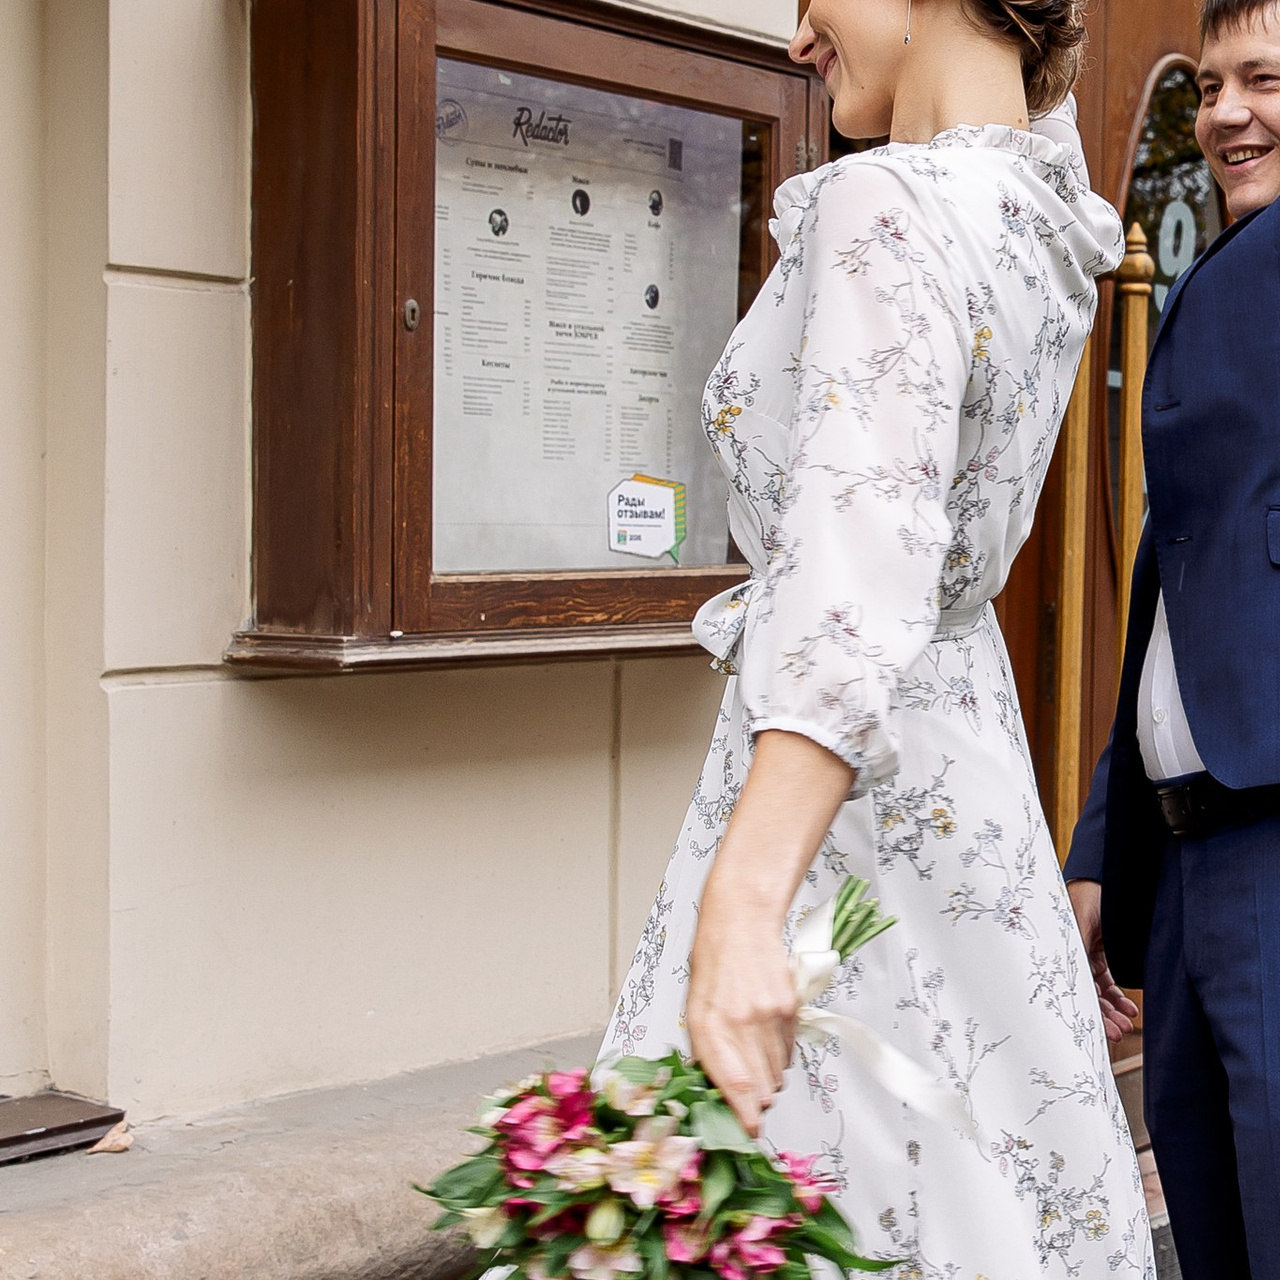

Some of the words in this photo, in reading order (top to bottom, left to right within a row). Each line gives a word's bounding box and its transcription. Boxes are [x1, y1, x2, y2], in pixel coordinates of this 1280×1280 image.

[512, 107, 572, 147] Redactor
[618, 494, 645, 507] Рады
[617, 508, 666, 519] отзывам!
